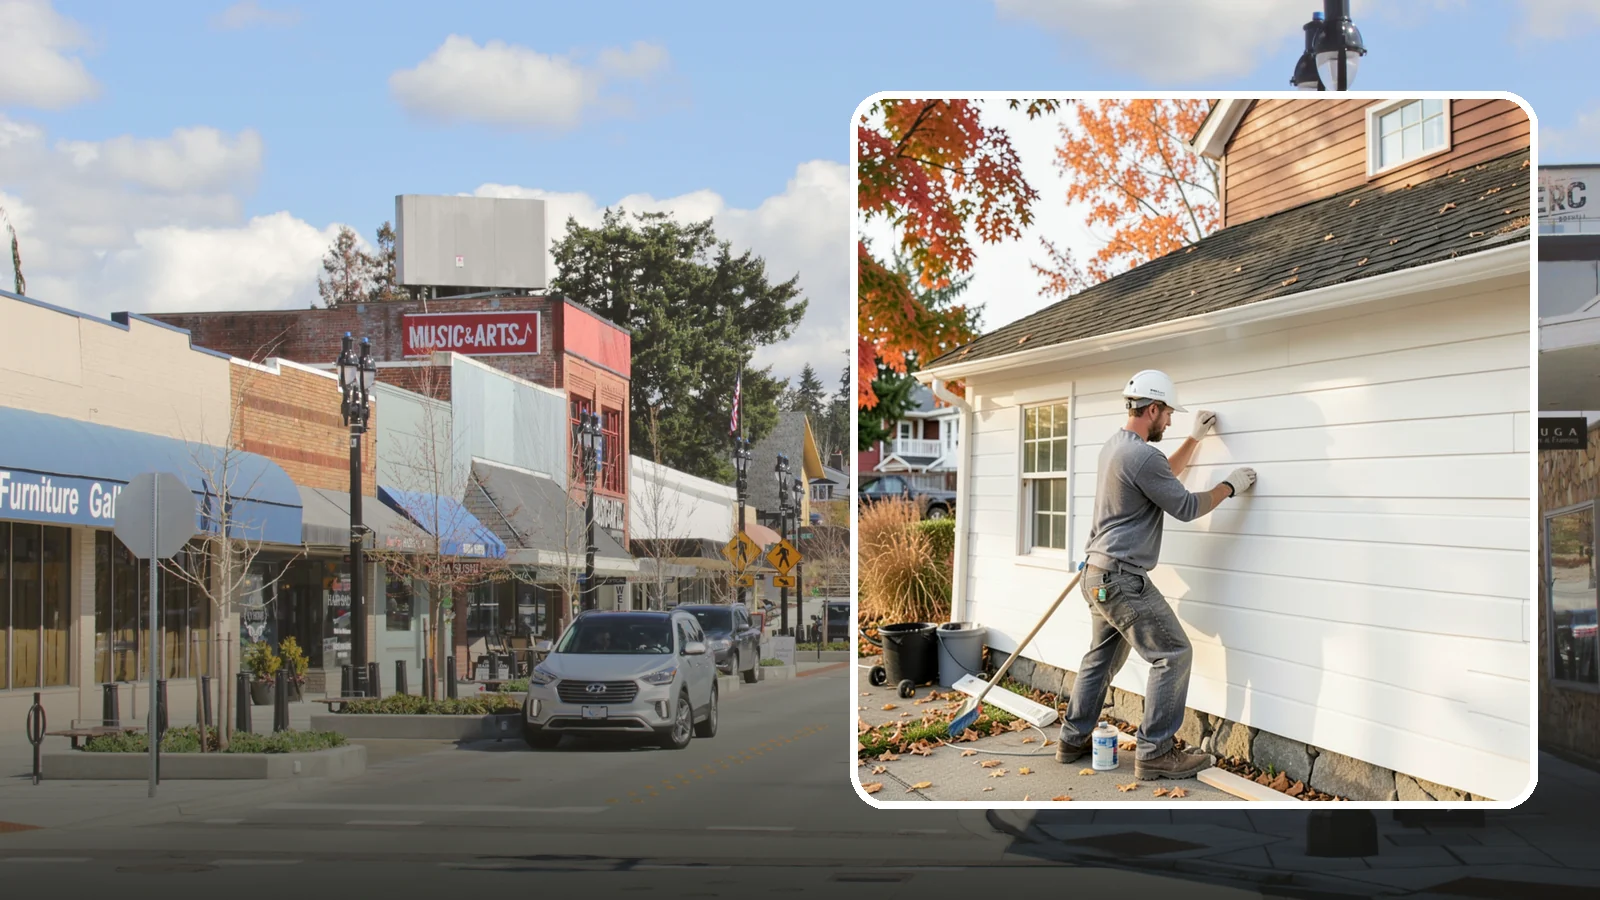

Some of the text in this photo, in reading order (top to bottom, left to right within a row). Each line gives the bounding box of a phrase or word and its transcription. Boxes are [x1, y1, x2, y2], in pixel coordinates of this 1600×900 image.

[409, 323, 519, 348] MUSIC&ARTS
[0, 471, 122, 519] Furniture Gal
